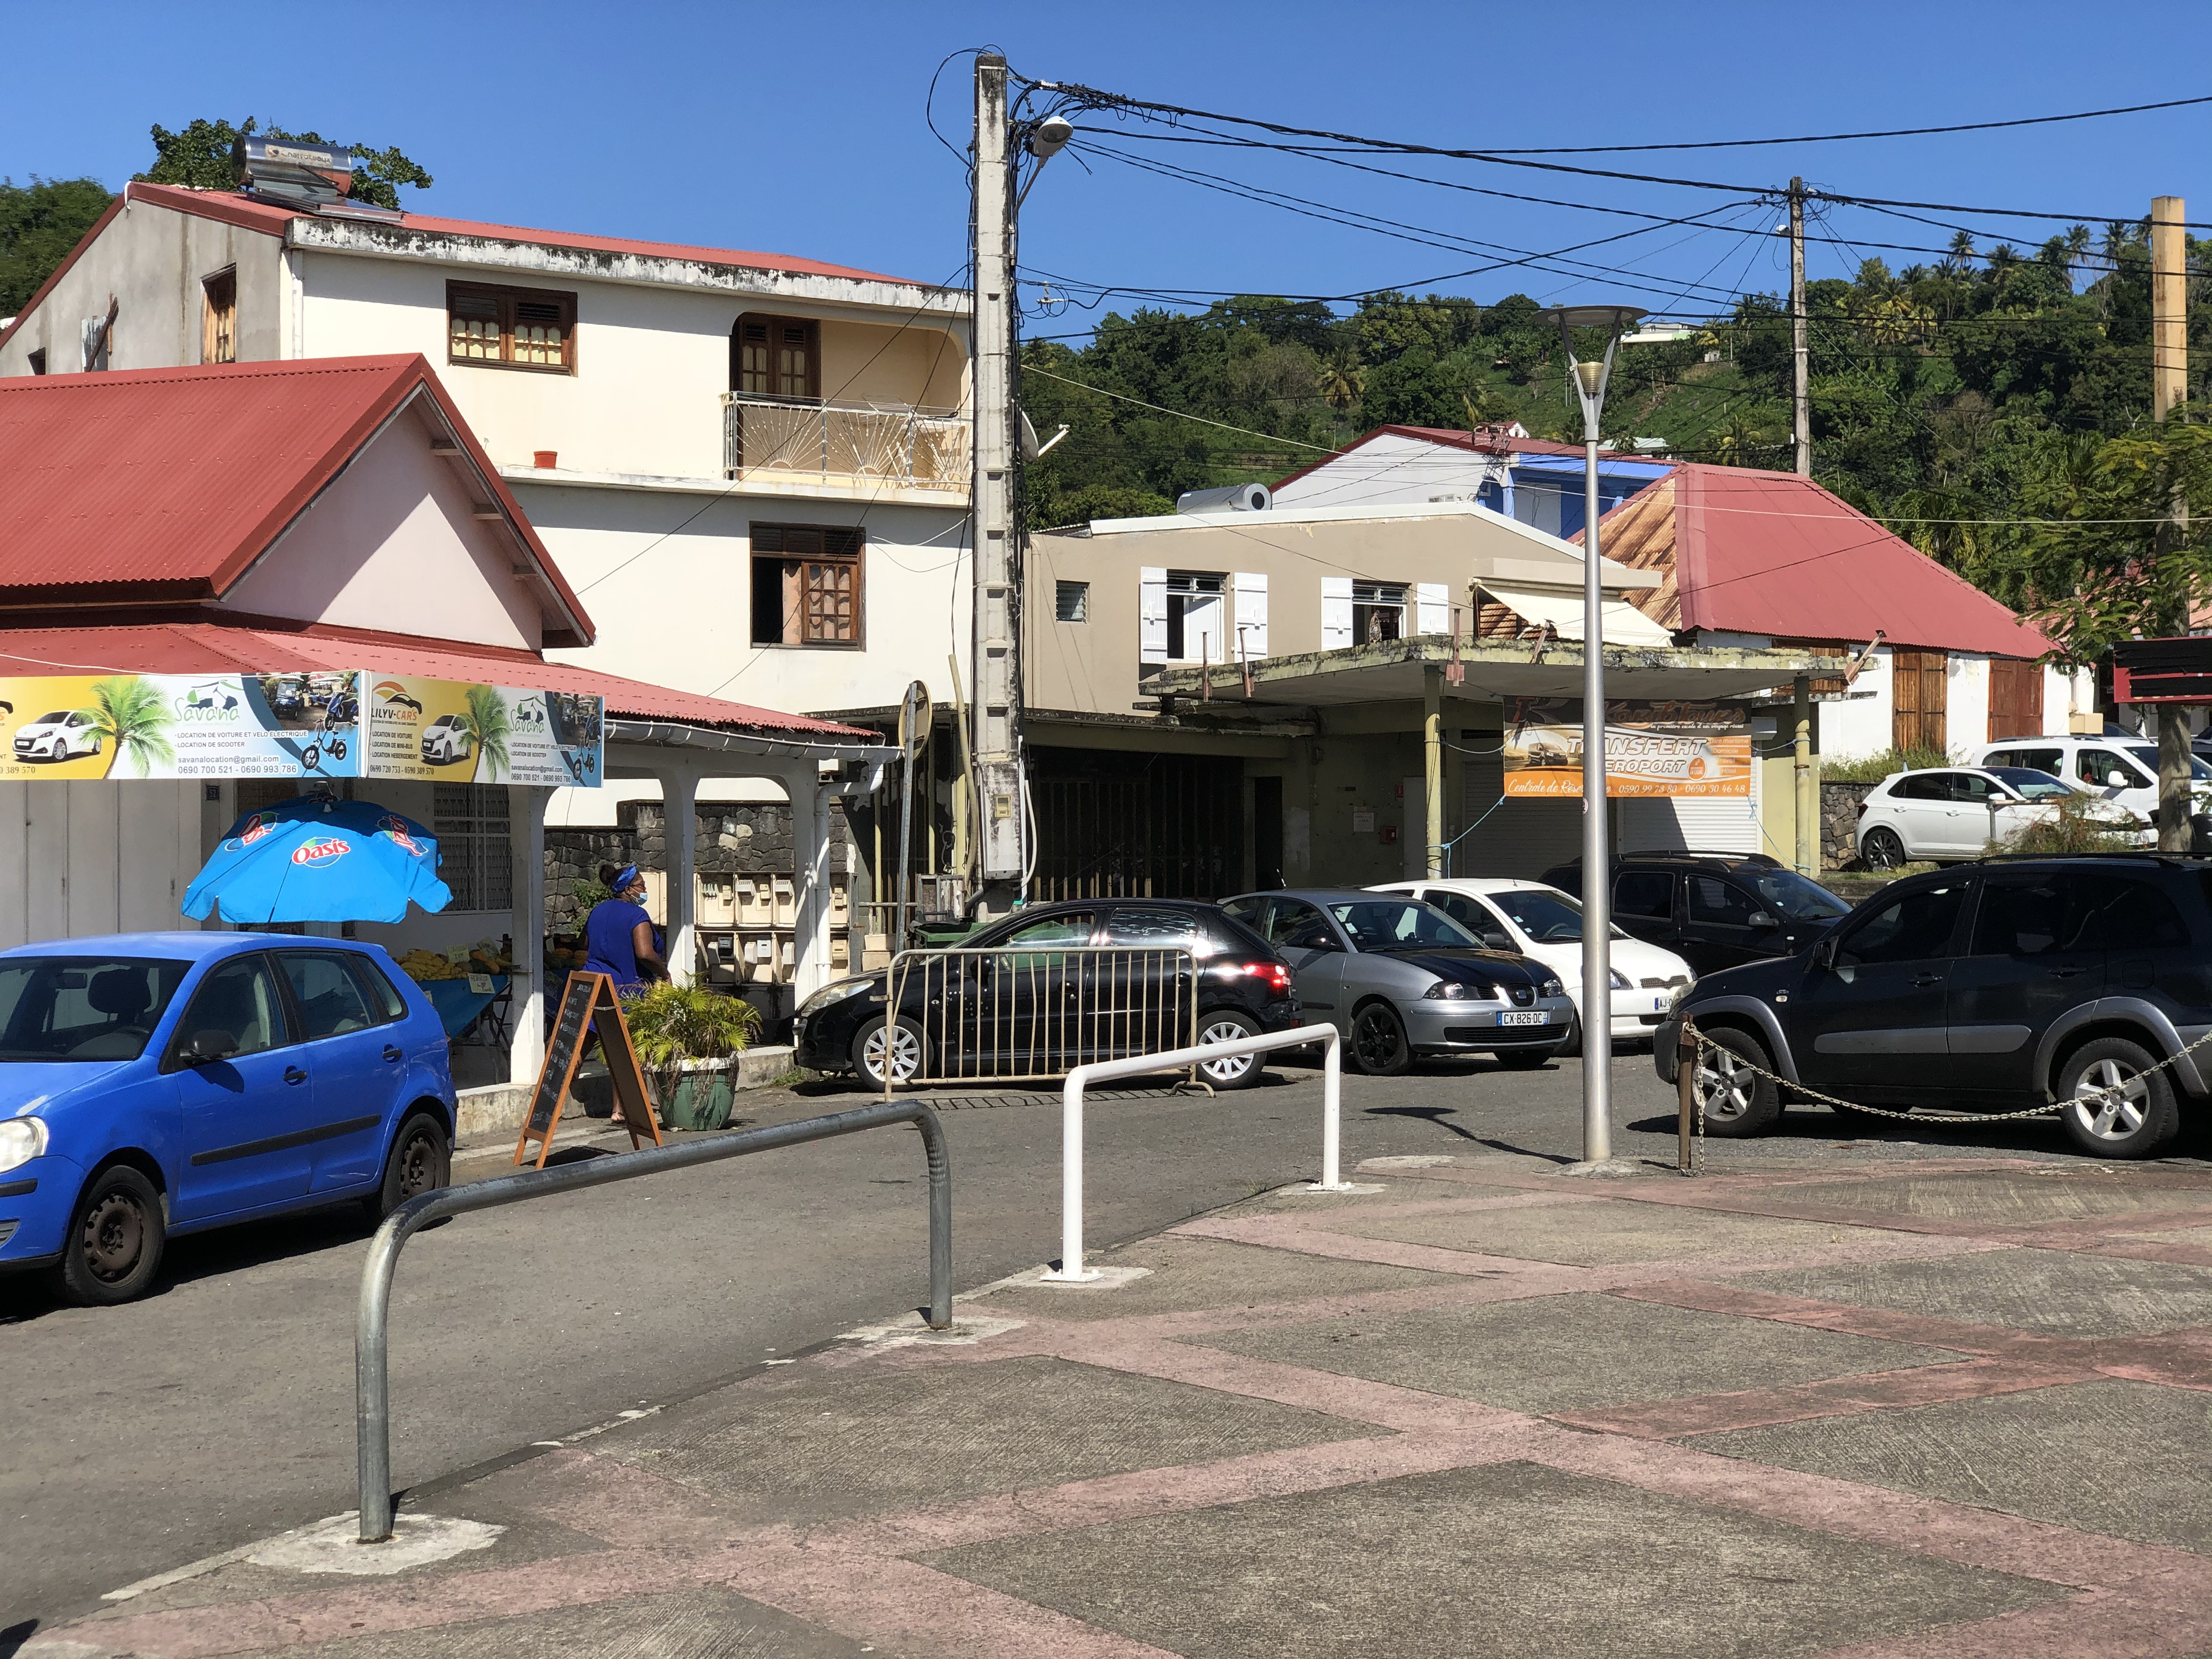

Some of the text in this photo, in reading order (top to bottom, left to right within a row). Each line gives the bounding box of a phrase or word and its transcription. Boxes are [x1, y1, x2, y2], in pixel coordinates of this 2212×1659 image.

[174, 697, 241, 722] Savana
[510, 708, 545, 734] Savana
[1567, 737, 1708, 755] TNSFERT
[178, 755, 279, 764] savanalocation@gmail.com
[1605, 759, 1687, 773] EROPORT
[281, 765, 297, 773] 786
[370, 764, 382, 773] 0690
[1508, 779, 1546, 793] Centrale
[1546, 780, 1559, 794] de
[1618, 785, 1640, 794] 0590
[1642, 785, 1652, 794] 99
[1667, 784, 1677, 793] 80
[1685, 784, 1706, 793] 0690
[1721, 784, 1732, 793] 46
[1735, 784, 1746, 793] 48
[293, 838, 351, 864] Oasis
[1504, 1013, 1542, 1024] CX-826-DC
